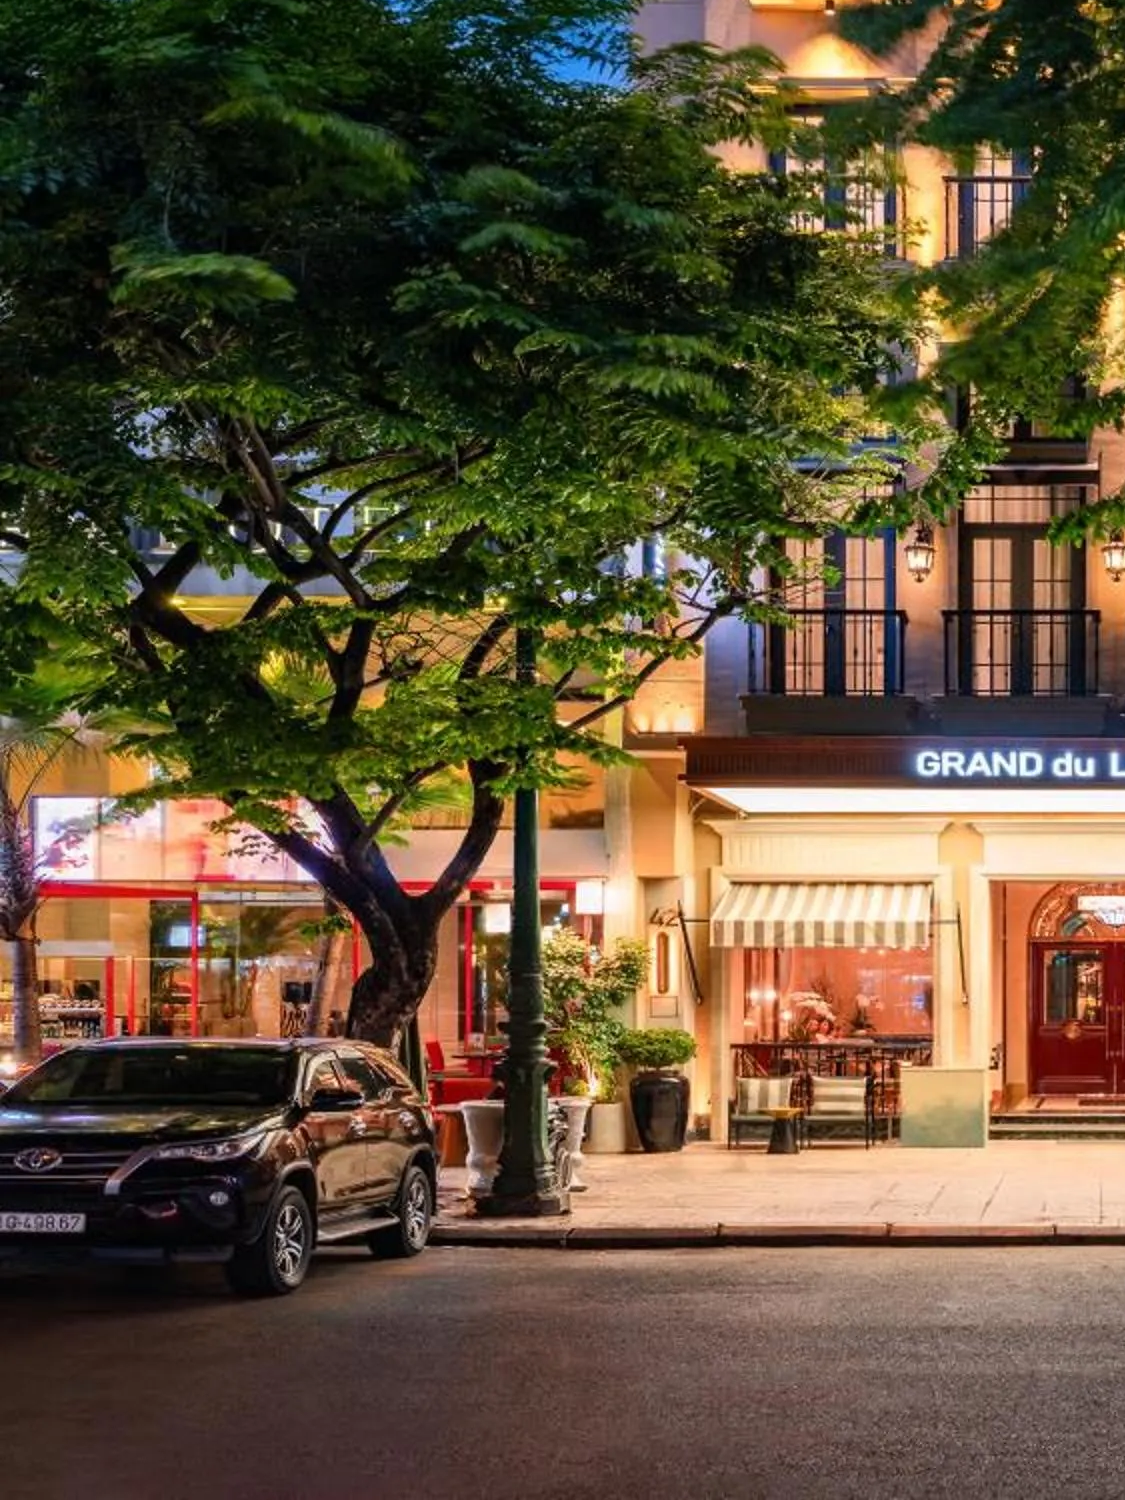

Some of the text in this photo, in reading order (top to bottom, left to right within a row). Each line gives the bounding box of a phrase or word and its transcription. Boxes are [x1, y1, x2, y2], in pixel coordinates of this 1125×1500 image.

[915, 750, 1043, 777] GRAND
[1052, 752, 1096, 777] du
[649, 907, 679, 927] 42
